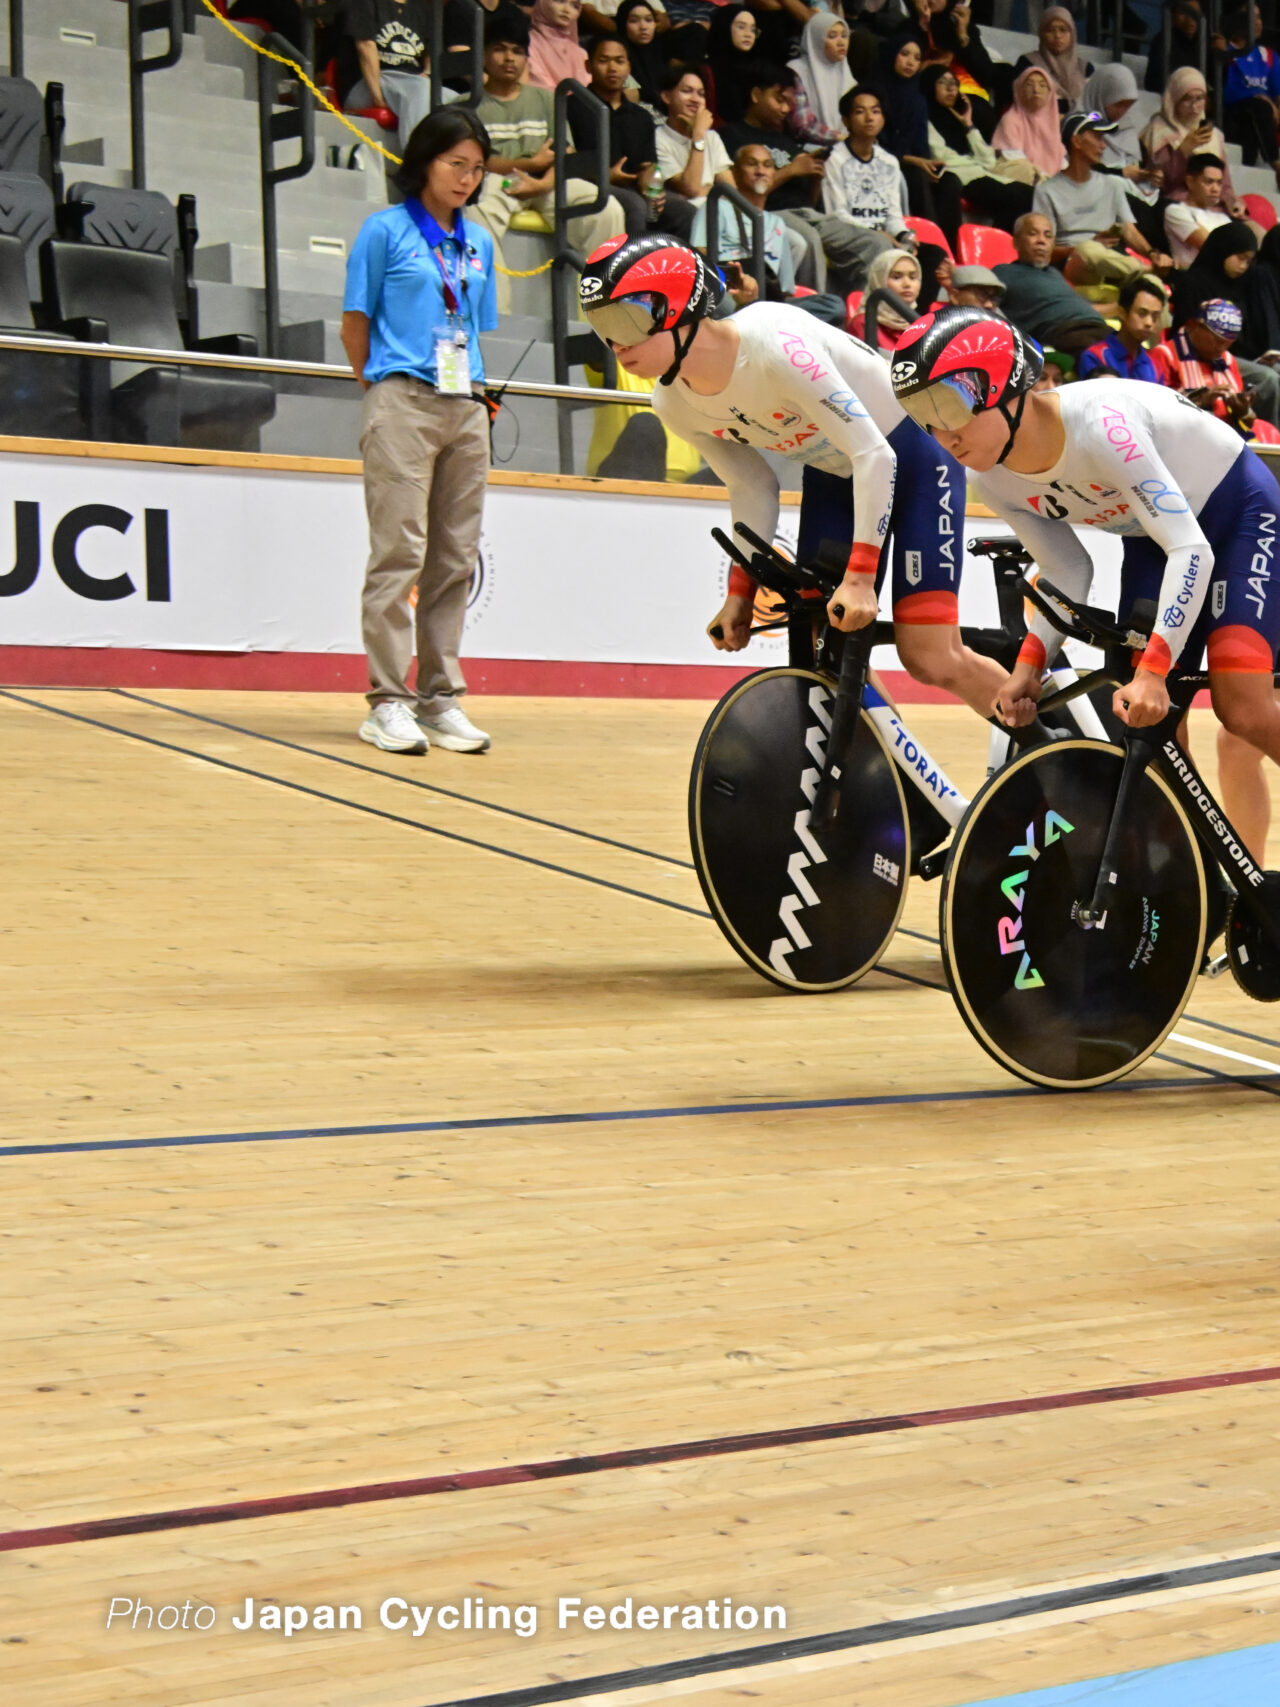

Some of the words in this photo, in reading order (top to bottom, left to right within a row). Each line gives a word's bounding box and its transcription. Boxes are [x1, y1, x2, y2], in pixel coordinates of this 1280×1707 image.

[936, 464, 955, 582] JAPAN
[1177, 553, 1200, 605] Cyclers
[1245, 513, 1277, 620] JAPAN
[1163, 740, 1265, 887] BRIDGESTONE
[997, 809, 1075, 990] ARAYA
[1141, 909, 1160, 965] JAPAN
